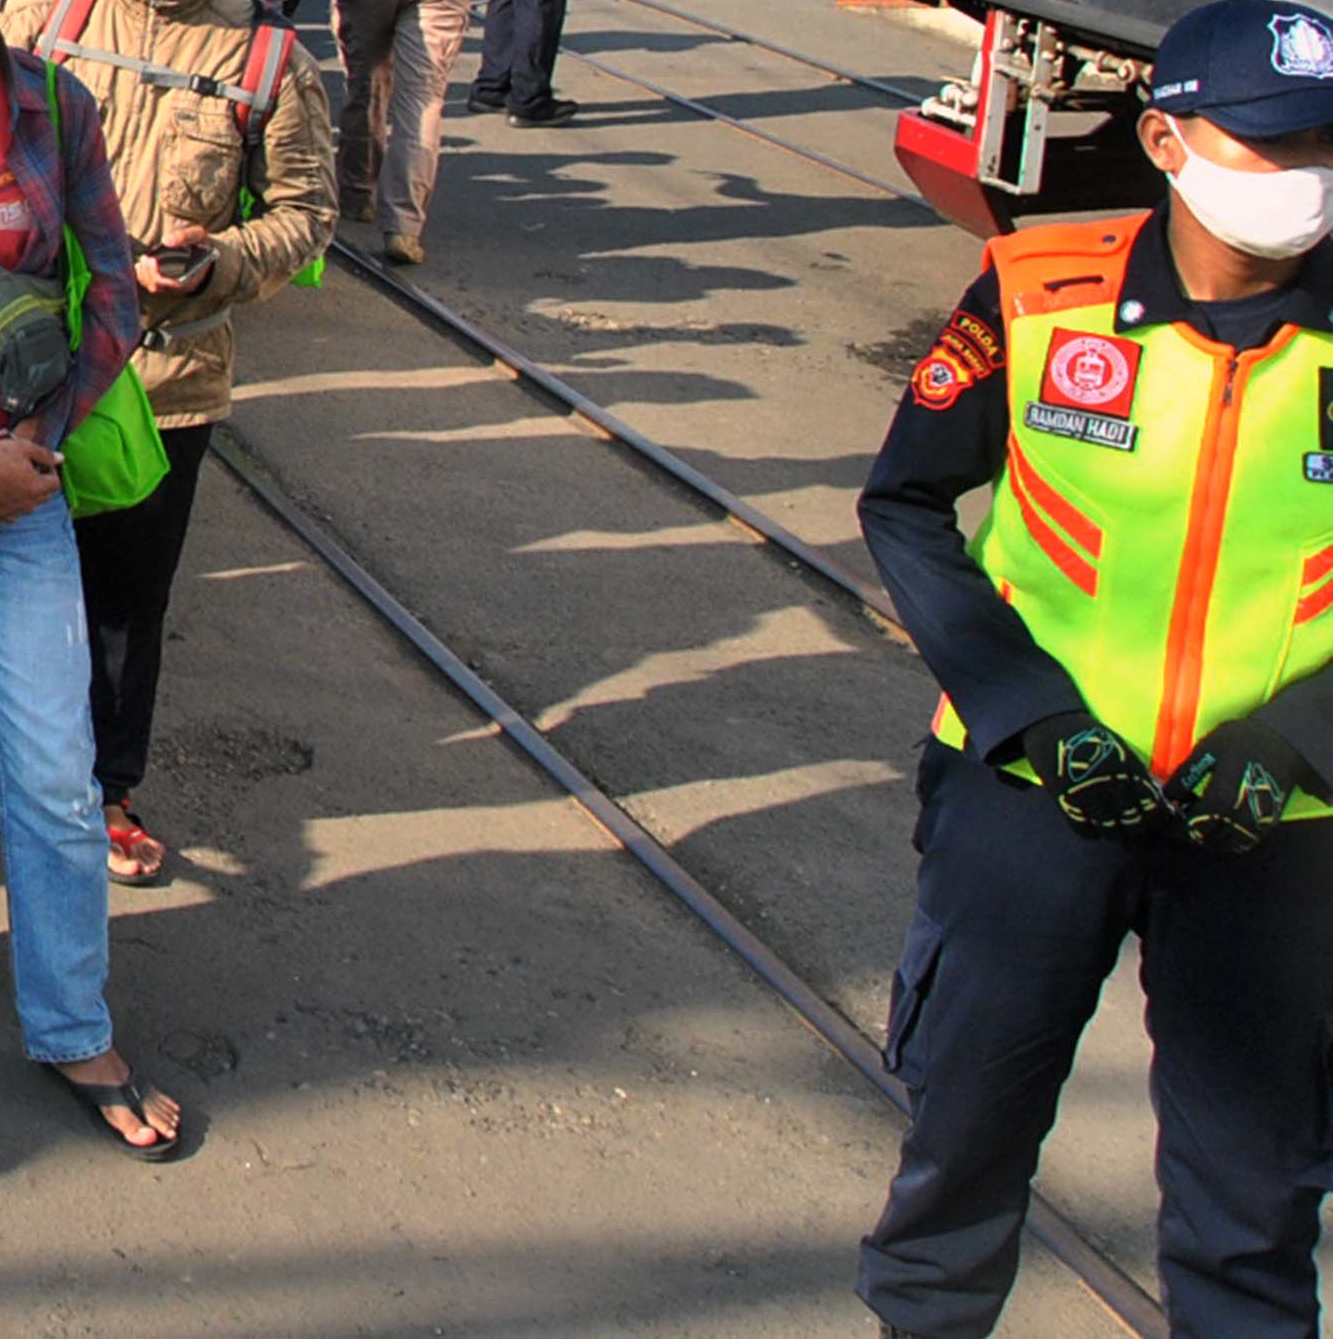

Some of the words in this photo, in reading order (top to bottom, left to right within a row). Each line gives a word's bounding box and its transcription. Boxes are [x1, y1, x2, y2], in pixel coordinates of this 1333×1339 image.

[959, 316, 998, 357] POLDA
[1029, 405, 1086, 433] RAMDAN
[1087, 418, 1126, 442] HADI
